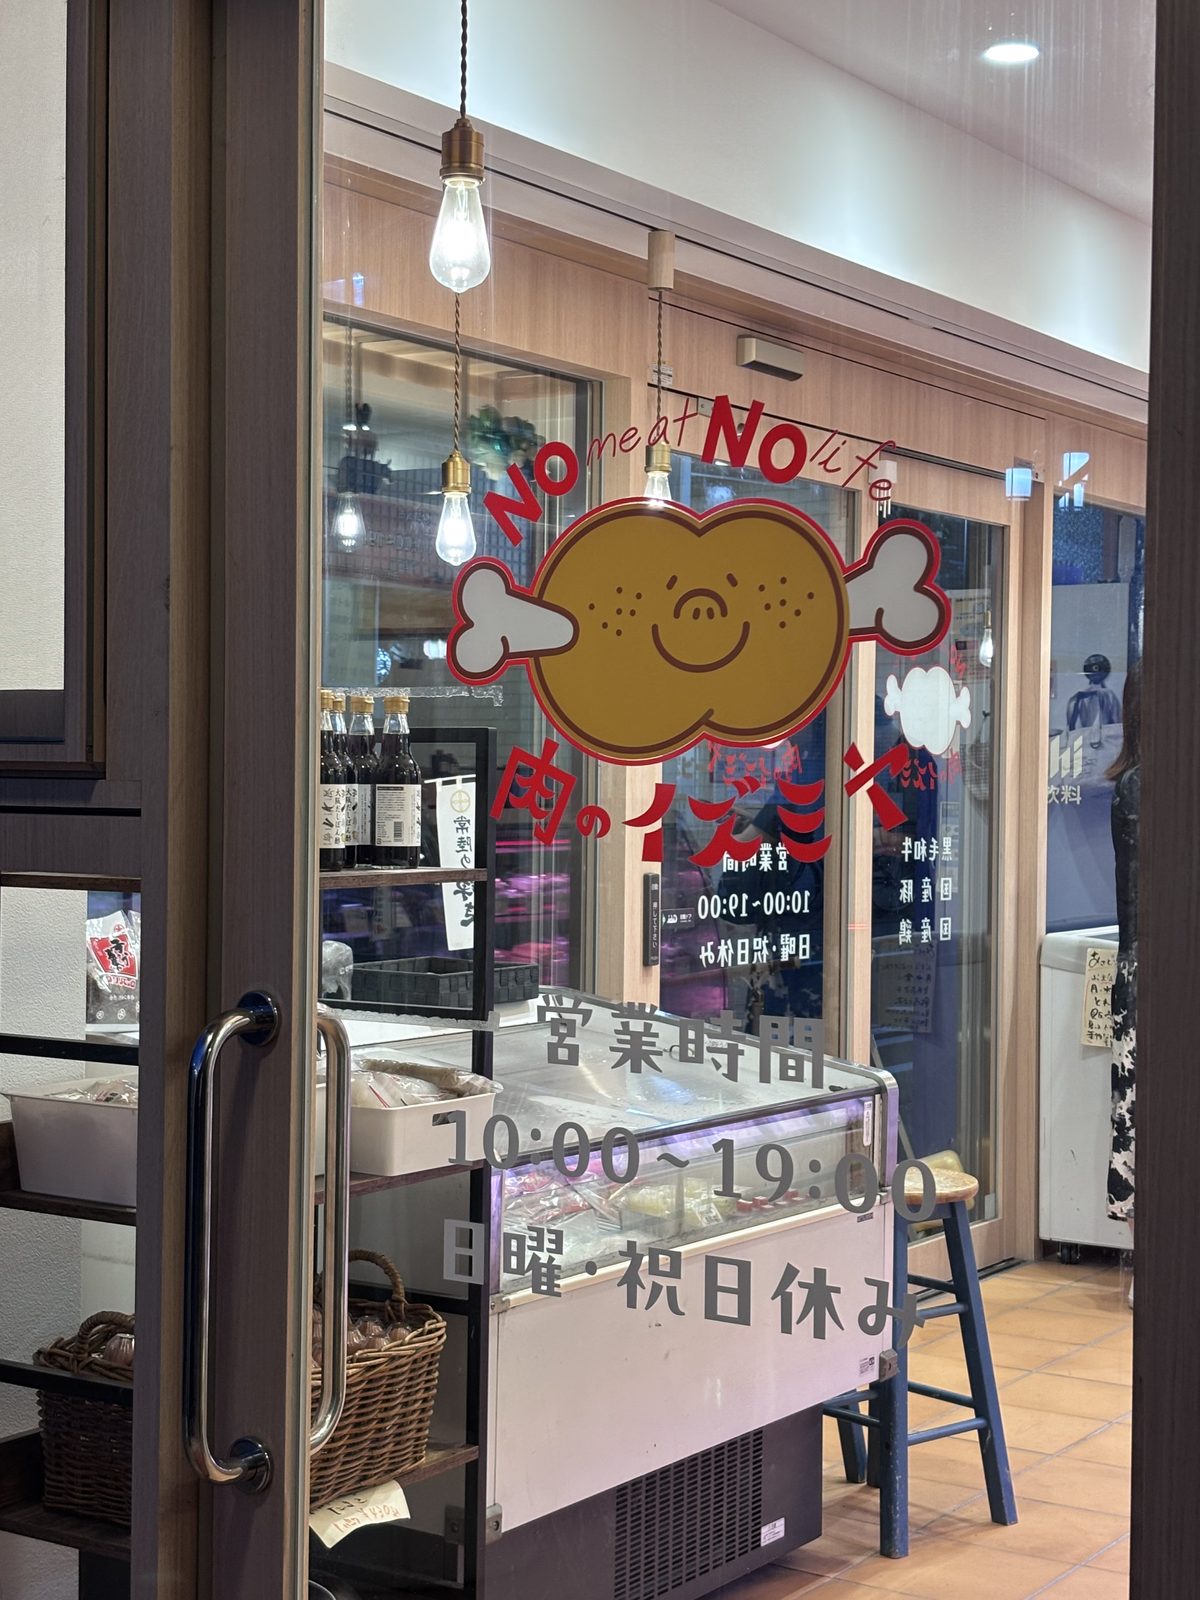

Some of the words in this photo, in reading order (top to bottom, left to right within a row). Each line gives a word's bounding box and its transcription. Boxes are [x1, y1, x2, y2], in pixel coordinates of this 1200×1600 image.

[586, 398, 698, 466] meat
[809, 429, 896, 501] life
[490, 737, 909, 867] 肉のイズミヤ
[537, 995, 824, 1089] 営業時間
[443, 1218, 925, 1347] 日曜・祝日休み
